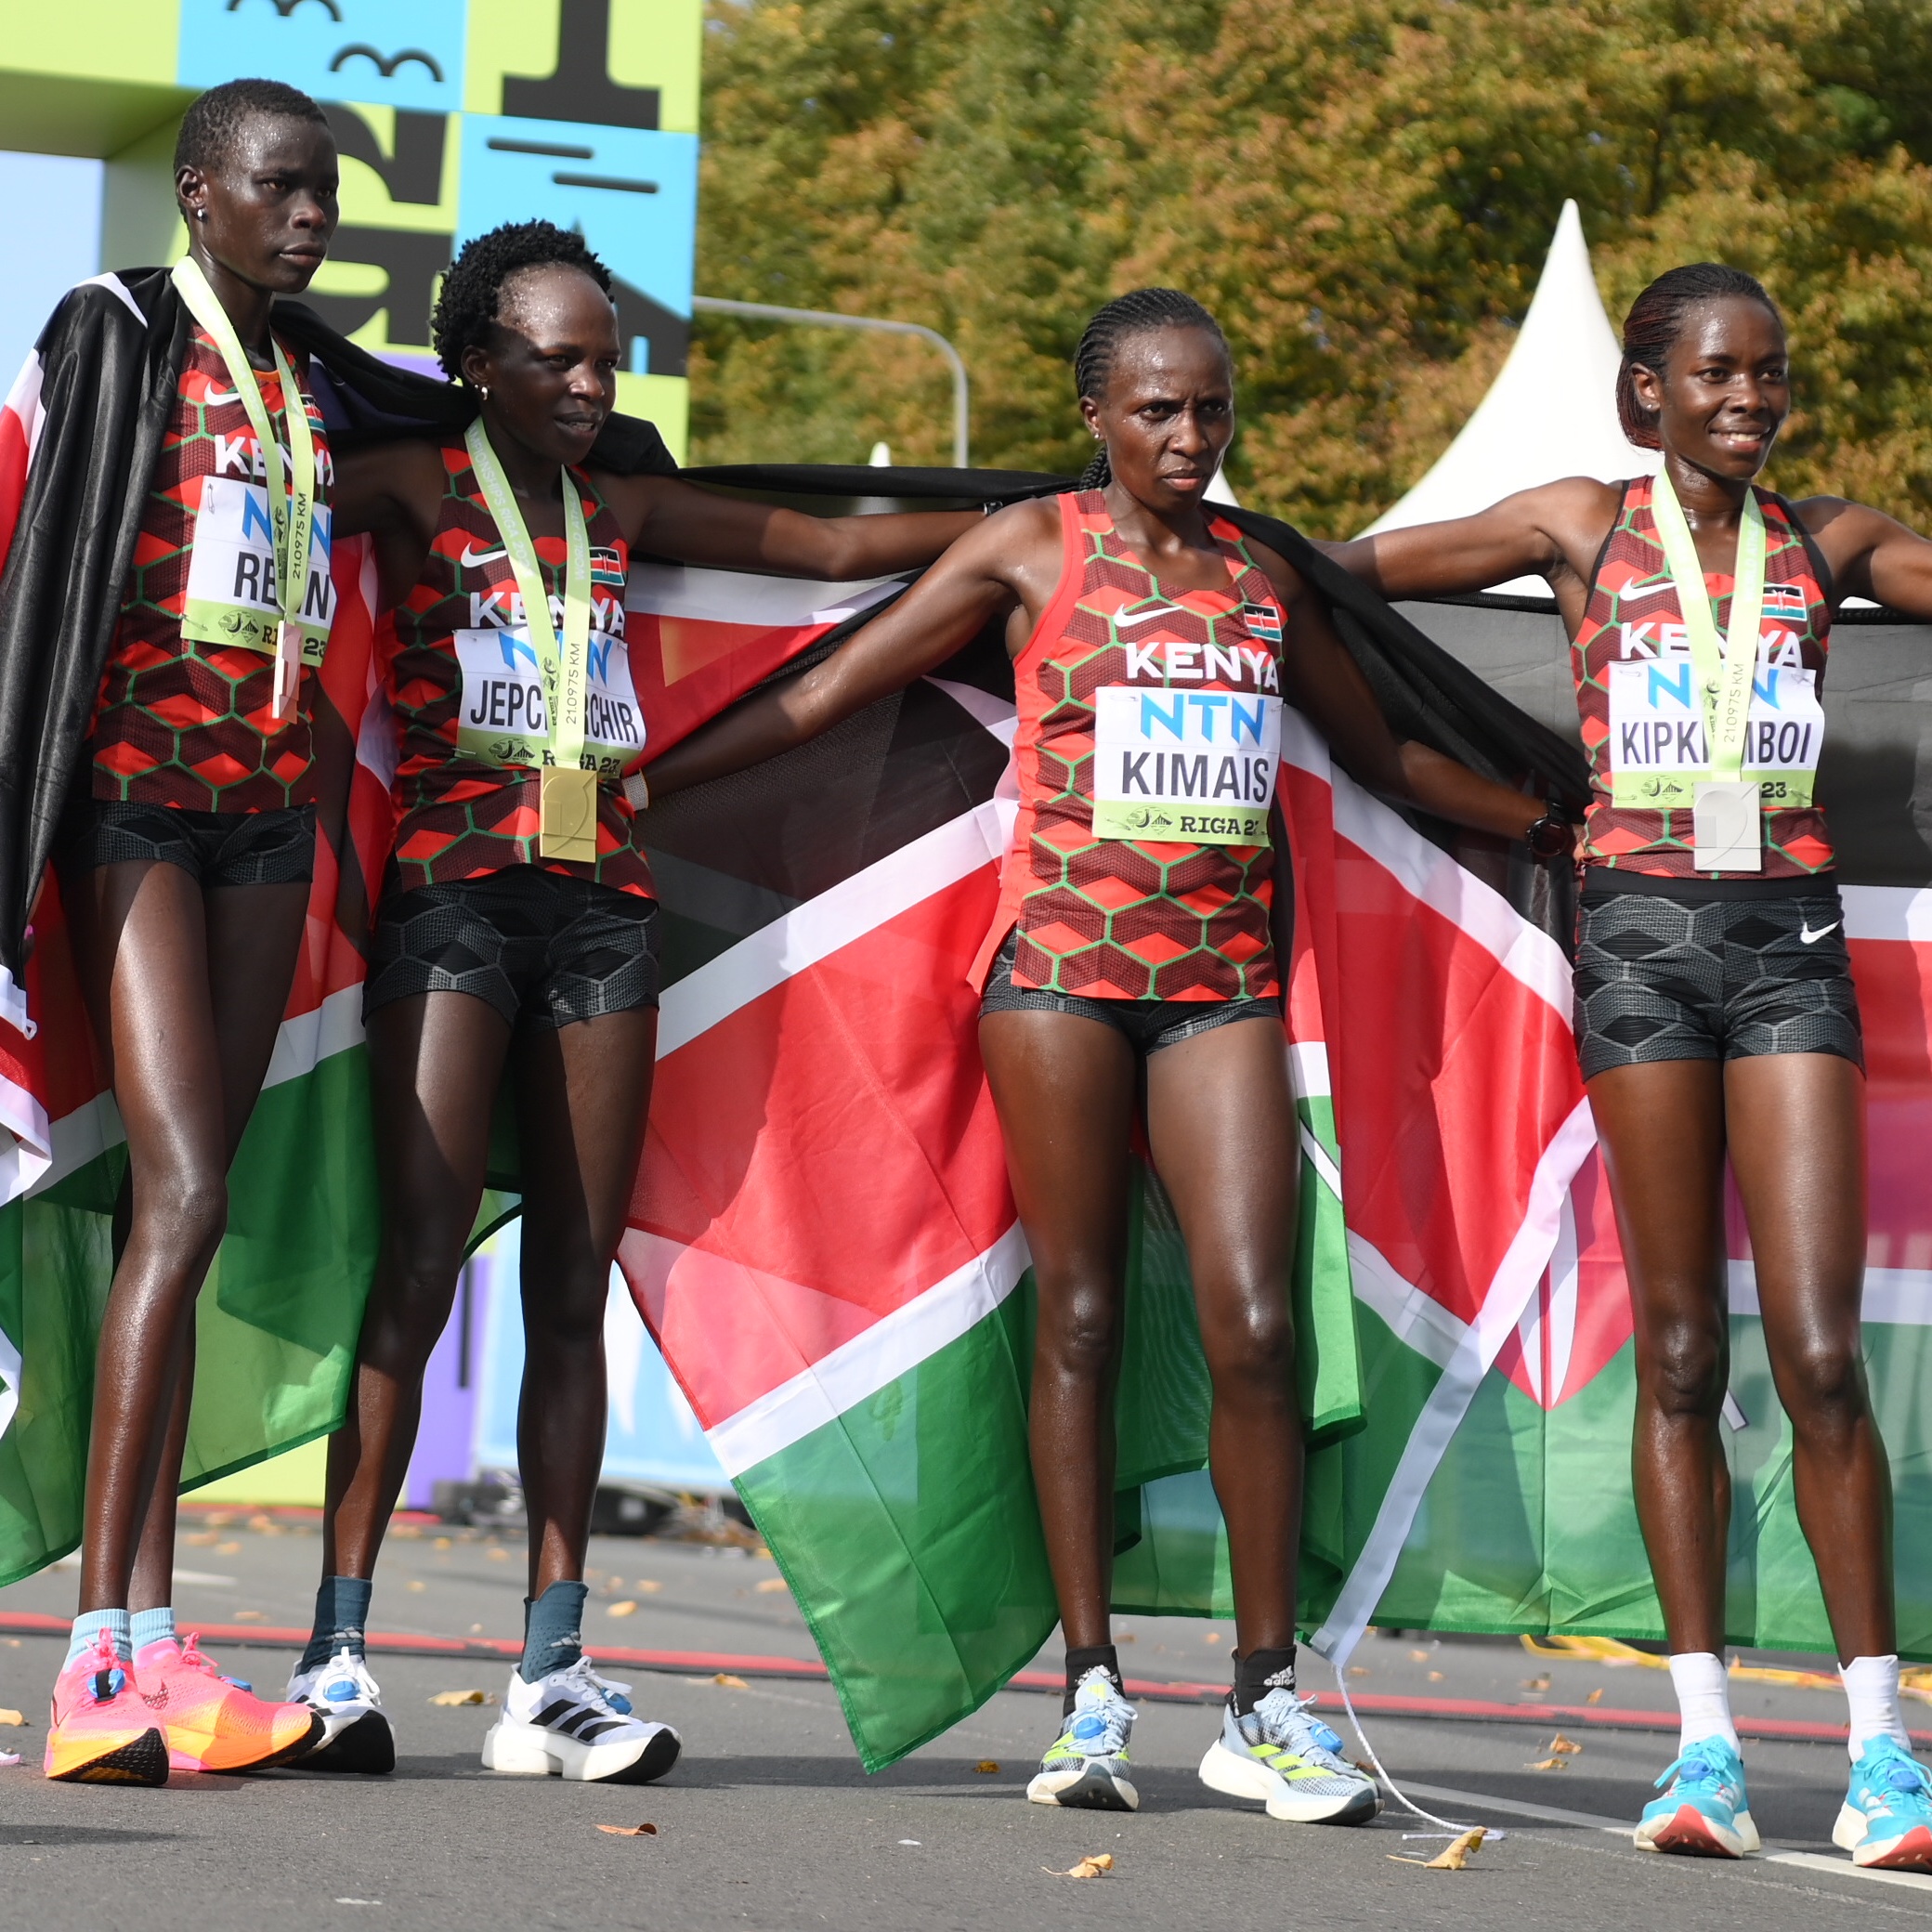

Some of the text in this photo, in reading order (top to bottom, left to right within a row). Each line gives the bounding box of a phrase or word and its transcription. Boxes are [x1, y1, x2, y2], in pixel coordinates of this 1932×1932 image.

[242, 487, 331, 560] NN
[293, 492, 307, 581] 21.0975 KM
[234, 551, 330, 620] REN
[513, 540, 536, 579] 202
[566, 642, 581, 725] 21.0975 KM
[1125, 642, 1280, 695] KENYA
[1648, 662, 1782, 711] NN
[470, 679, 639, 744] JEPCCHIR
[1140, 692, 1266, 747] NTN
[1724, 663, 1744, 743] 21.0975 KM
[1121, 751, 1270, 803] KIMAIS
[1761, 781, 1787, 799] 23
[1180, 815, 1242, 835] RIGA
[1264, 1675, 1297, 1687] adid
